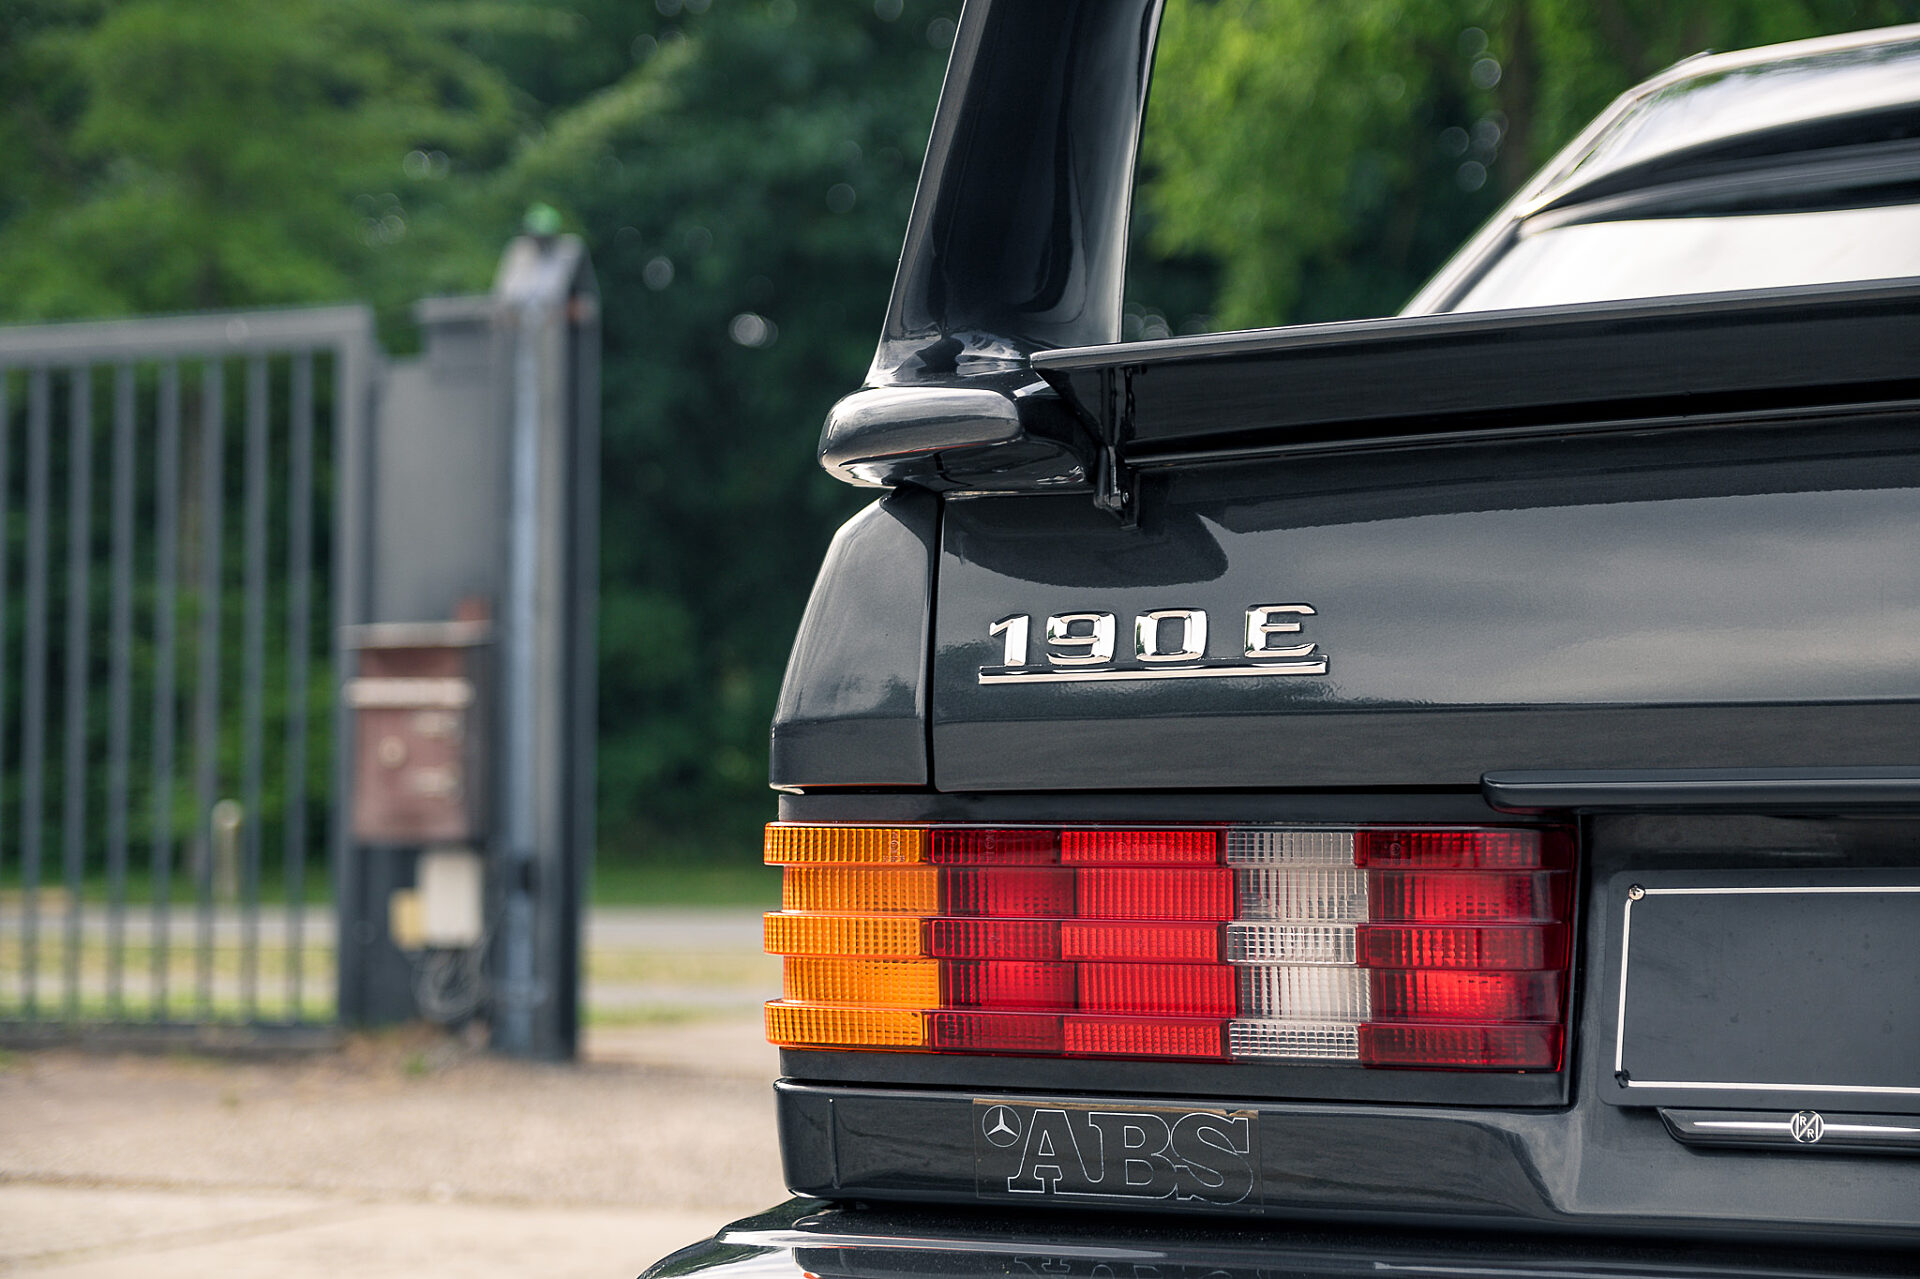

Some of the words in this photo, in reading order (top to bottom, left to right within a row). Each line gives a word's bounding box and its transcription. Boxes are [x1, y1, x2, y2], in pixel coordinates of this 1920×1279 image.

[989, 608, 1207, 666] 190
[1245, 603, 1318, 658] E
[1008, 1109, 1254, 1206] ABS
